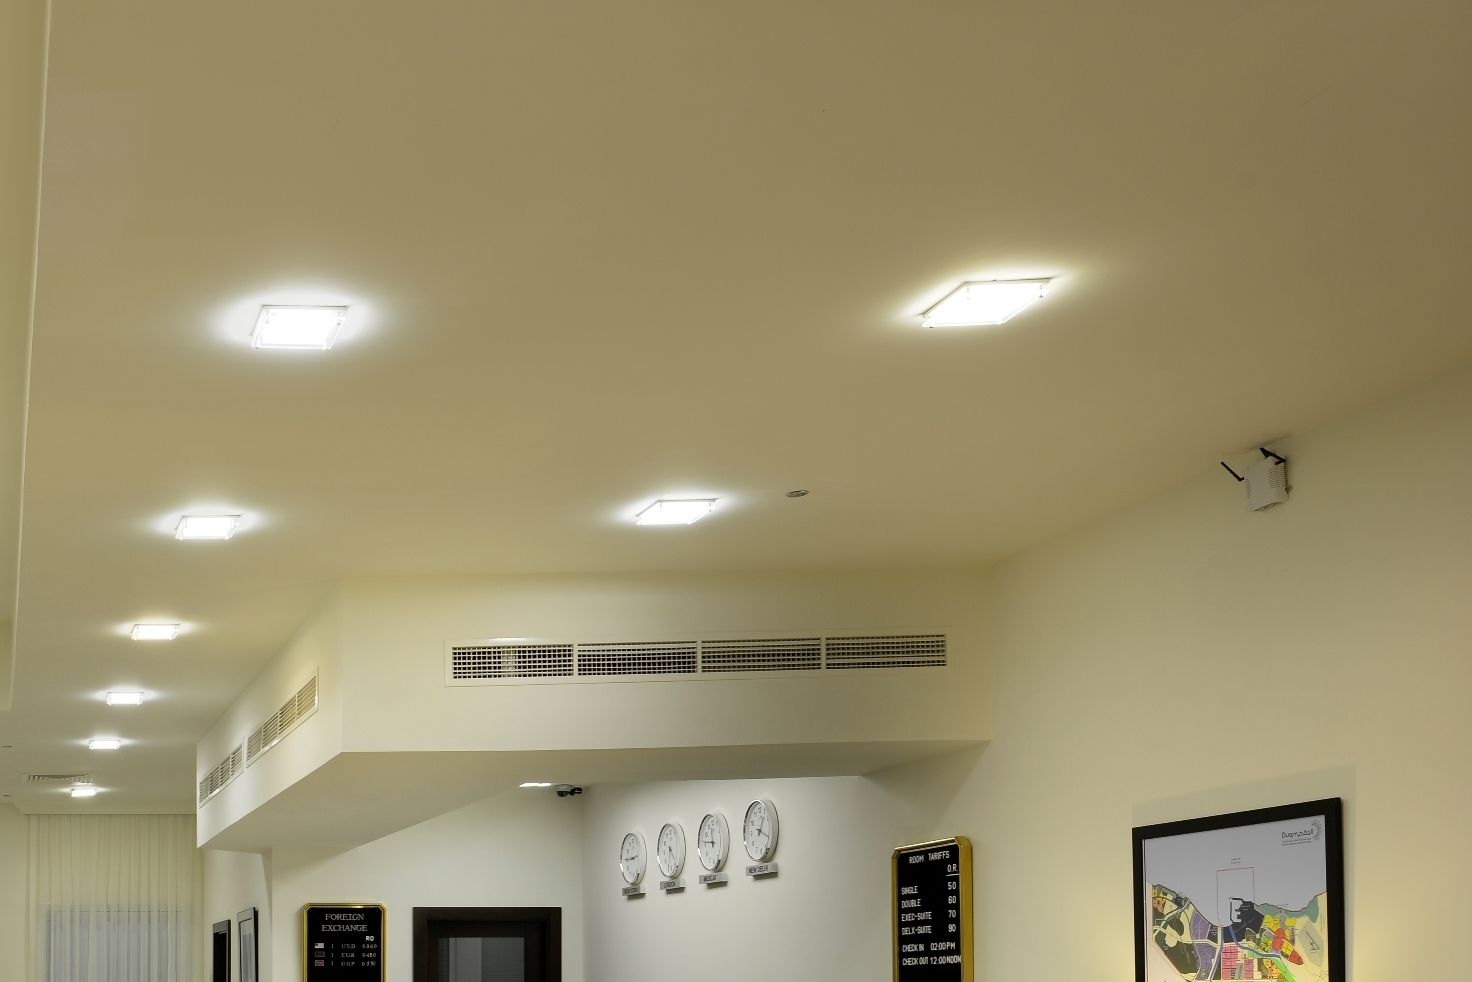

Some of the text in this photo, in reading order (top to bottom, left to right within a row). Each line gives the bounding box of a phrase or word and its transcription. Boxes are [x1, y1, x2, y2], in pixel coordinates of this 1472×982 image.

[908, 851, 950, 864] ROOM TARIFFS
[901, 881, 957, 895] SINGLE 50
[901, 895, 957, 908] DOUBLE 60
[325, 913, 365, 921] FOREIGN
[947, 909, 957, 918] 70
[321, 924, 368, 932] EXCHANGE
[947, 923, 957, 933] 90
[902, 943, 918, 953] CHECK
[918, 943, 925, 952] IN
[902, 957, 918, 966] CHECK
[919, 956, 929, 965] OUT
